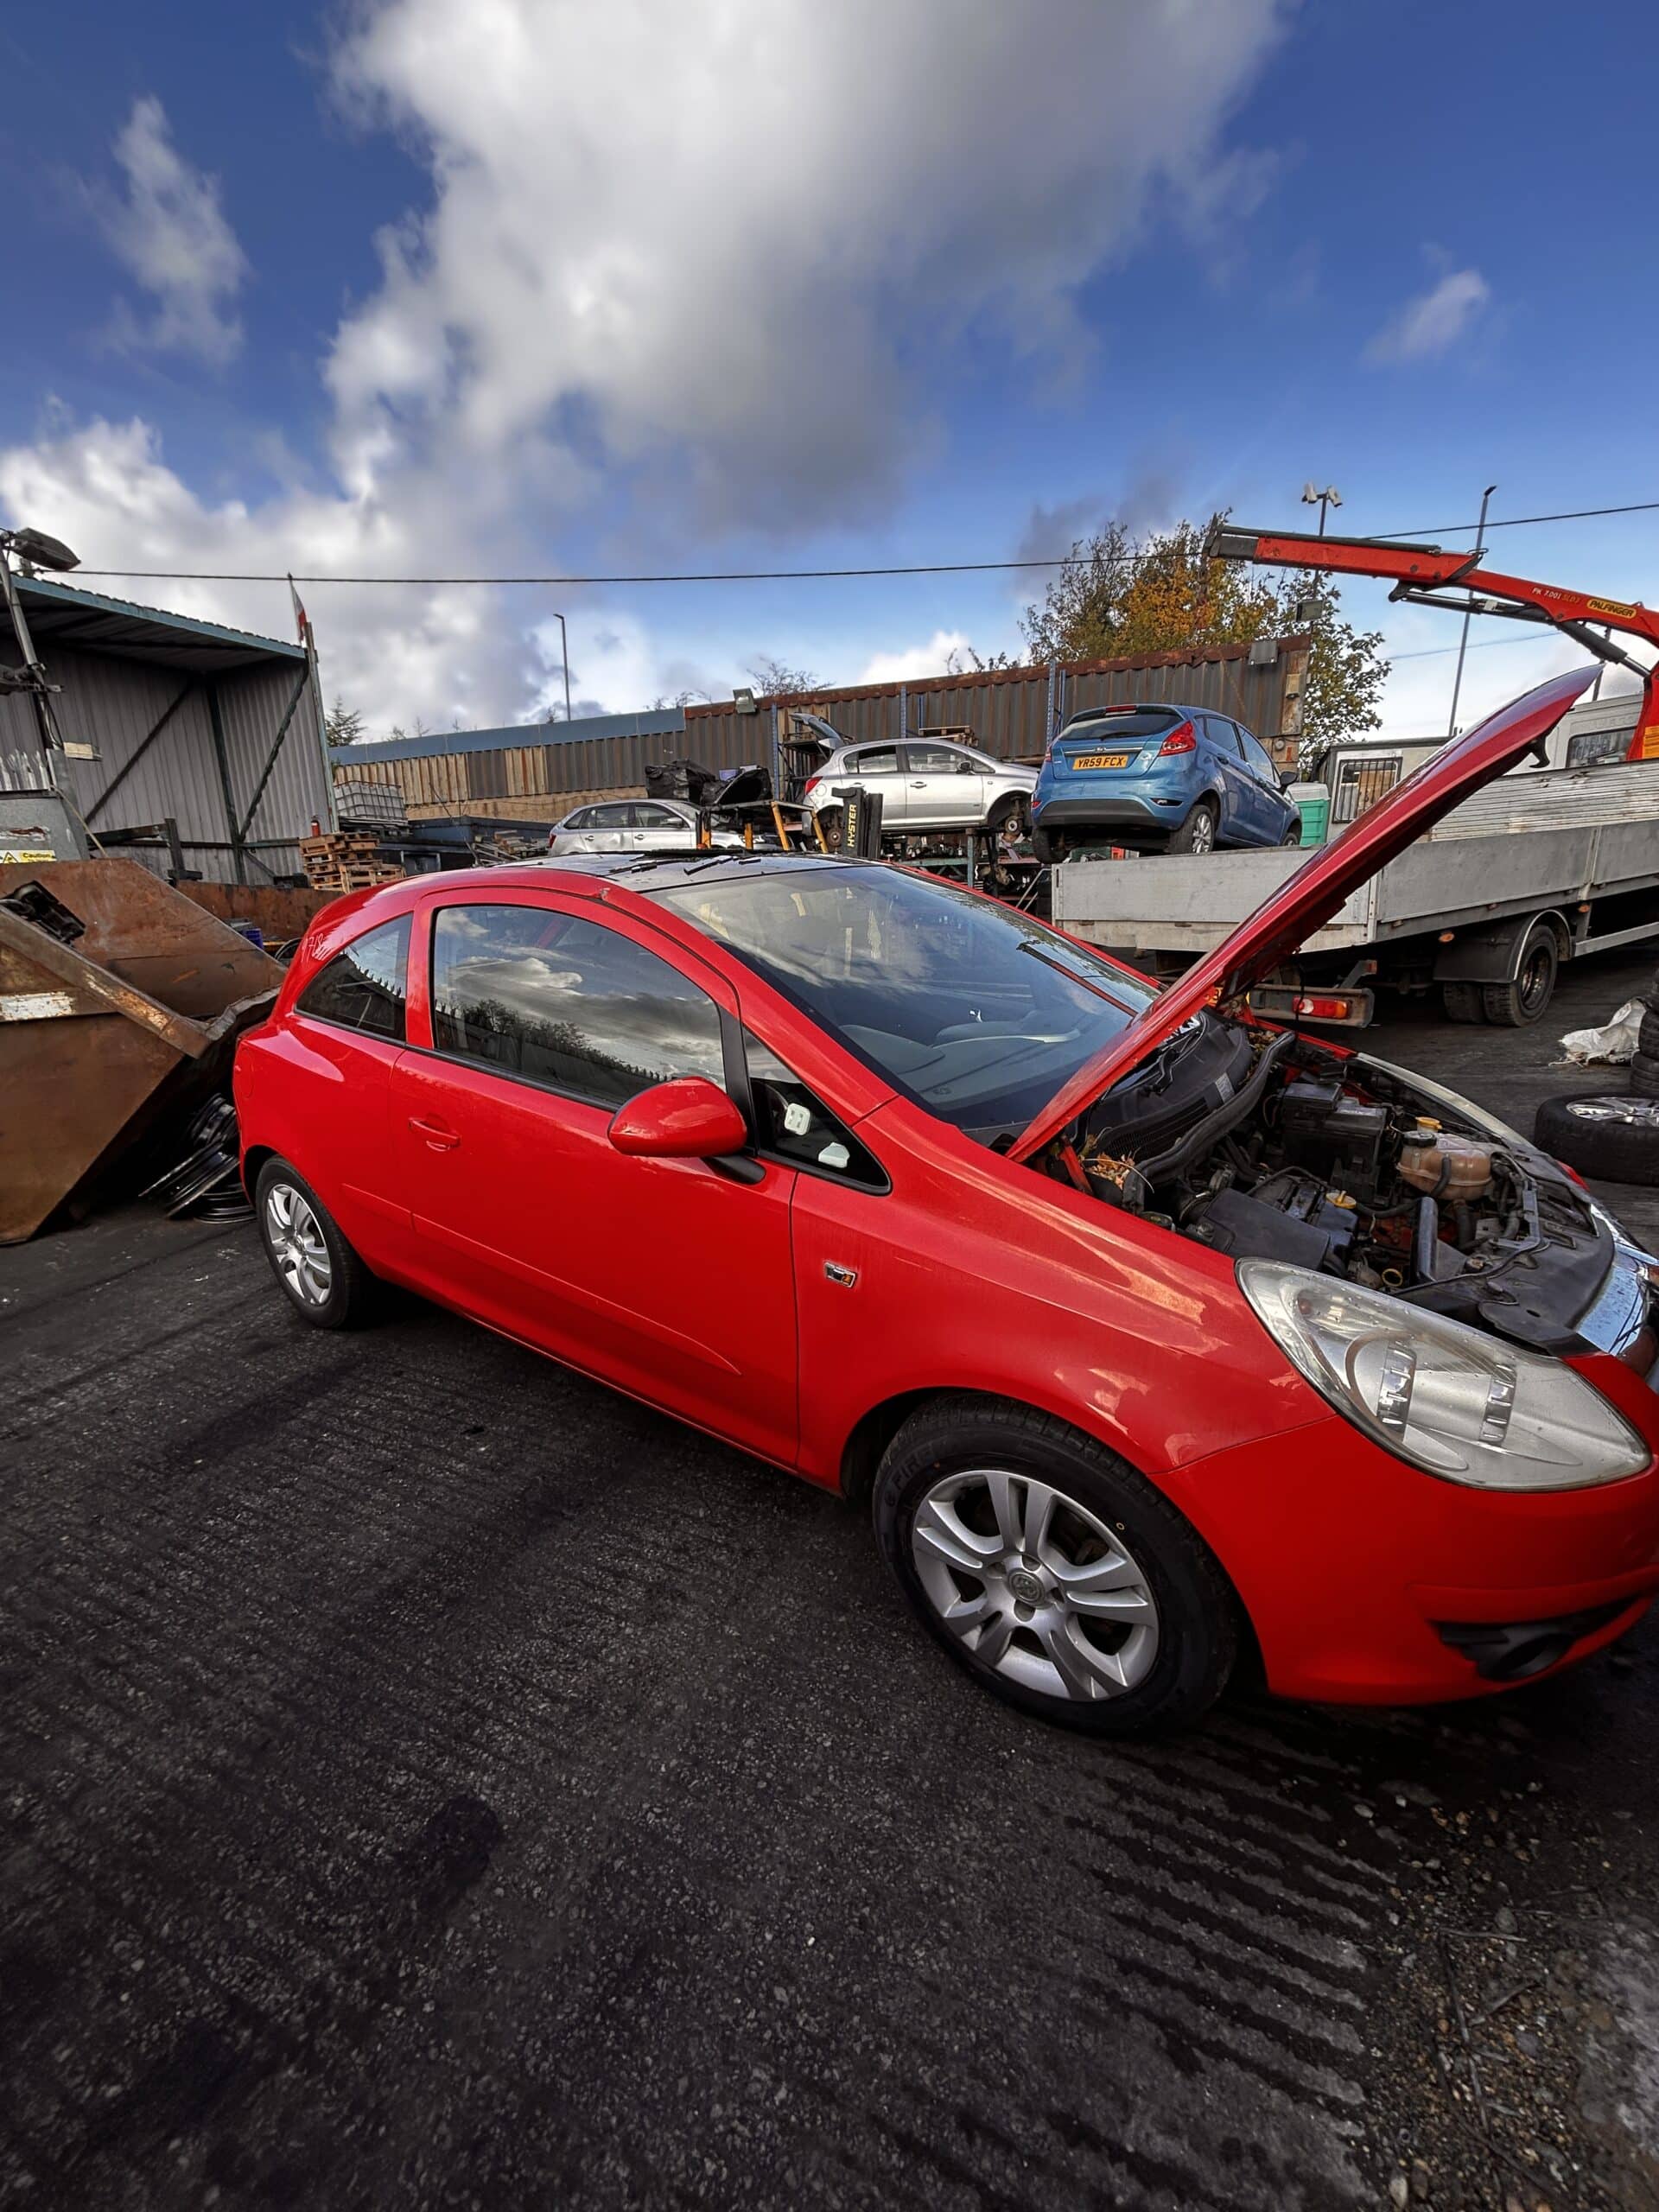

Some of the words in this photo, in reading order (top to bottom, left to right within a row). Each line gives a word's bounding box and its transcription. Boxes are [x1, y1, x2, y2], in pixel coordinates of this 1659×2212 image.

[1590, 601, 1635, 617] PALFINGER
[1077, 757, 1102, 768] YR59
[1103, 756, 1125, 766] FCX
[848, 804, 857, 848] HYSTER
